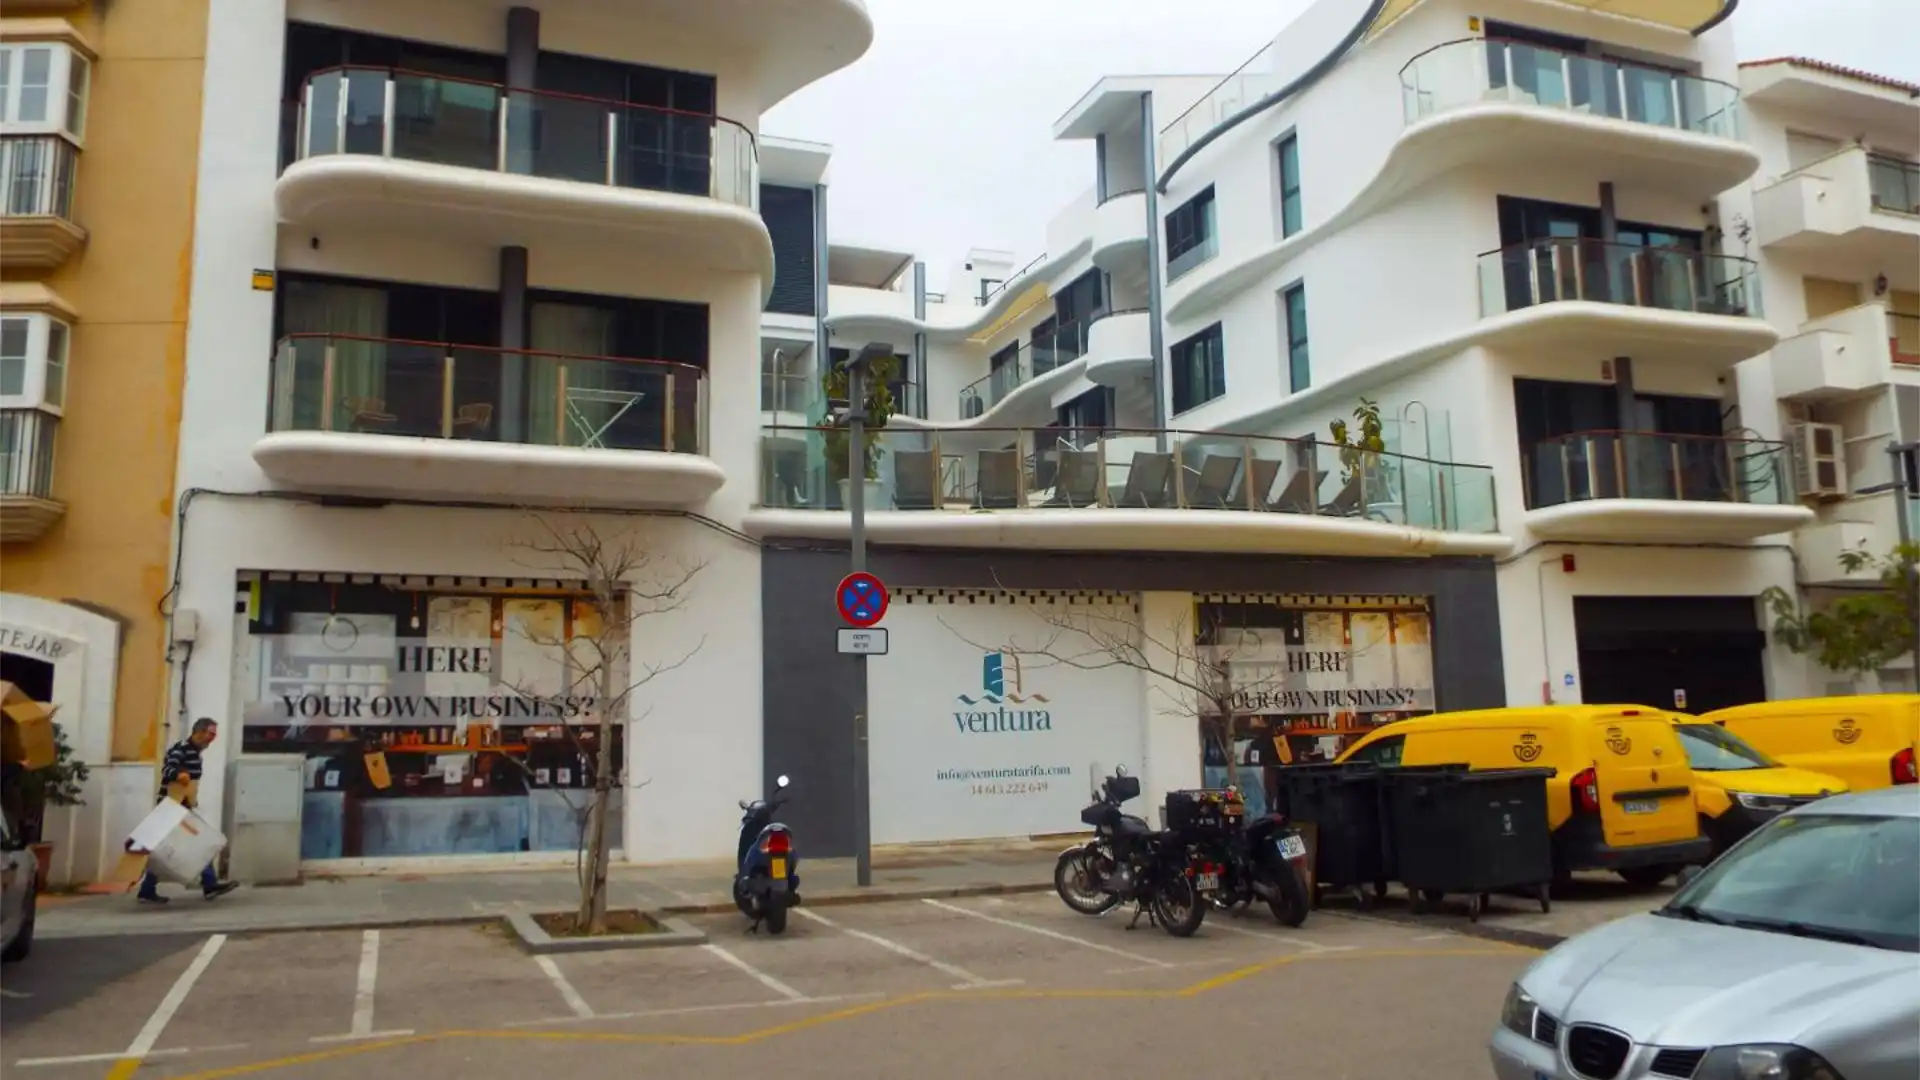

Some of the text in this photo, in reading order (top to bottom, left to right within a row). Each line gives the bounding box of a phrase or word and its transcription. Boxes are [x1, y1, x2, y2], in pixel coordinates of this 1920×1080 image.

[398, 645, 493, 674] HERE
[1287, 650, 1349, 673] HERE
[283, 694, 595, 718] YOUR OWN BUSINESS?
[1219, 687, 1415, 710] OUR OWN BUSINESS?
[953, 706, 1052, 733] ventura
